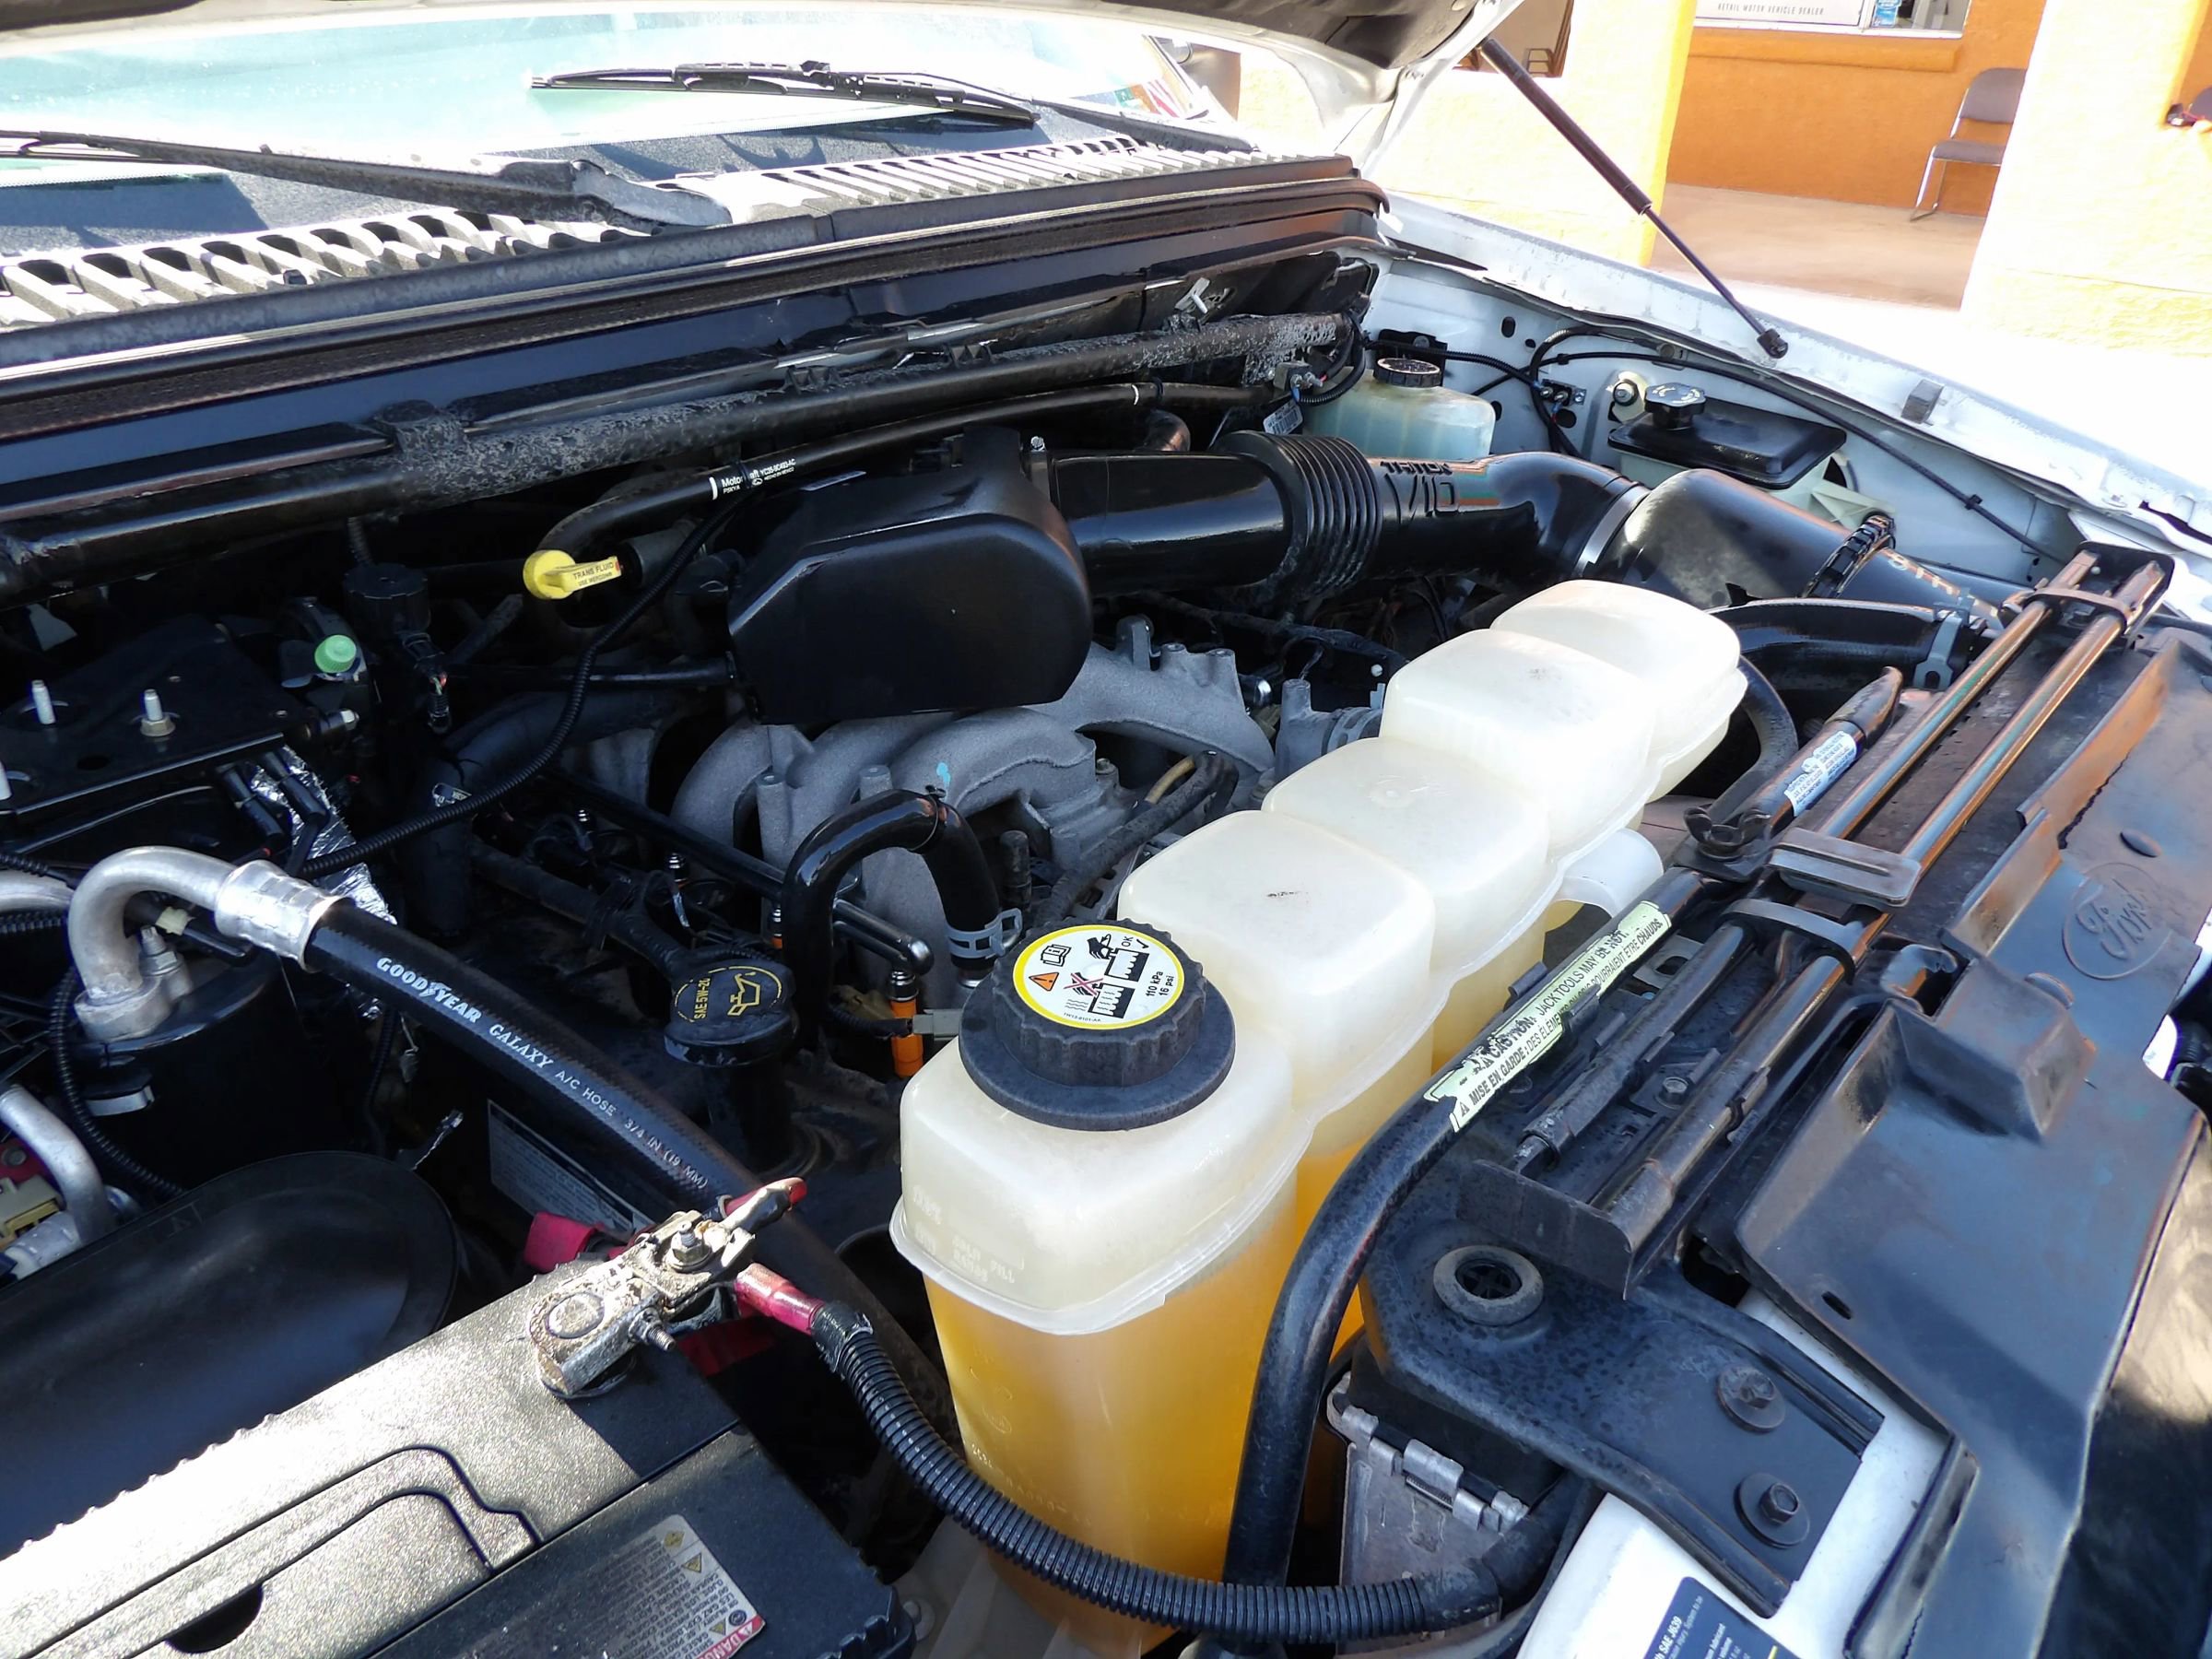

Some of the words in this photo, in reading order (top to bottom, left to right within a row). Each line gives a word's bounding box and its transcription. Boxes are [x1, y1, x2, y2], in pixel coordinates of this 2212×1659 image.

[1718, 3, 1739, 12] RETAIL
[1743, 4, 1764, 13] MOTOR
[1768, 6, 1795, 15] VEHICLE
[1798, 6, 1824, 16] DEALER
[721, 469, 760, 488] Motoraft
[573, 568, 595, 580] TRANS
[595, 562, 614, 574] FLUID
[1122, 935, 1134, 947] OK
[1150, 971, 1164, 985] kPa
[1158, 986, 1170, 996] 16
[1164, 975, 1175, 988] psi
[1535, 992, 1561, 1016] JACK
[1553, 971, 1584, 996] TOOLS
[1579, 955, 1599, 973] MAY
[1594, 943, 1611, 959] BE
[1145, 984, 1158, 997] 110
[692, 1001, 707, 1020] SAE
[376, 957, 483, 1024] GOODYEAR
[488, 1024, 554, 1069] GALAXY
[555, 1069, 581, 1090] A/C
[582, 1087, 618, 1117] HOSE
[624, 1118, 646, 1139] 3/4
[646, 1135, 664, 1153] IN
[663, 1148, 682, 1167] (19
[683, 1164, 710, 1190] MM)
[1468, 1080, 1491, 1105] MISE
[1488, 1069, 1502, 1088] EN
[1526, 1032, 1542, 1052] DES
[717, 1591, 735, 1606] LES
[700, 1601, 721, 1619] GAZ
[679, 1630, 710, 1654] GASES
[1659, 1633, 1674, 1654] SAE
[1668, 1615, 1682, 1637] J639
[698, 1632, 739, 1659] DANG
